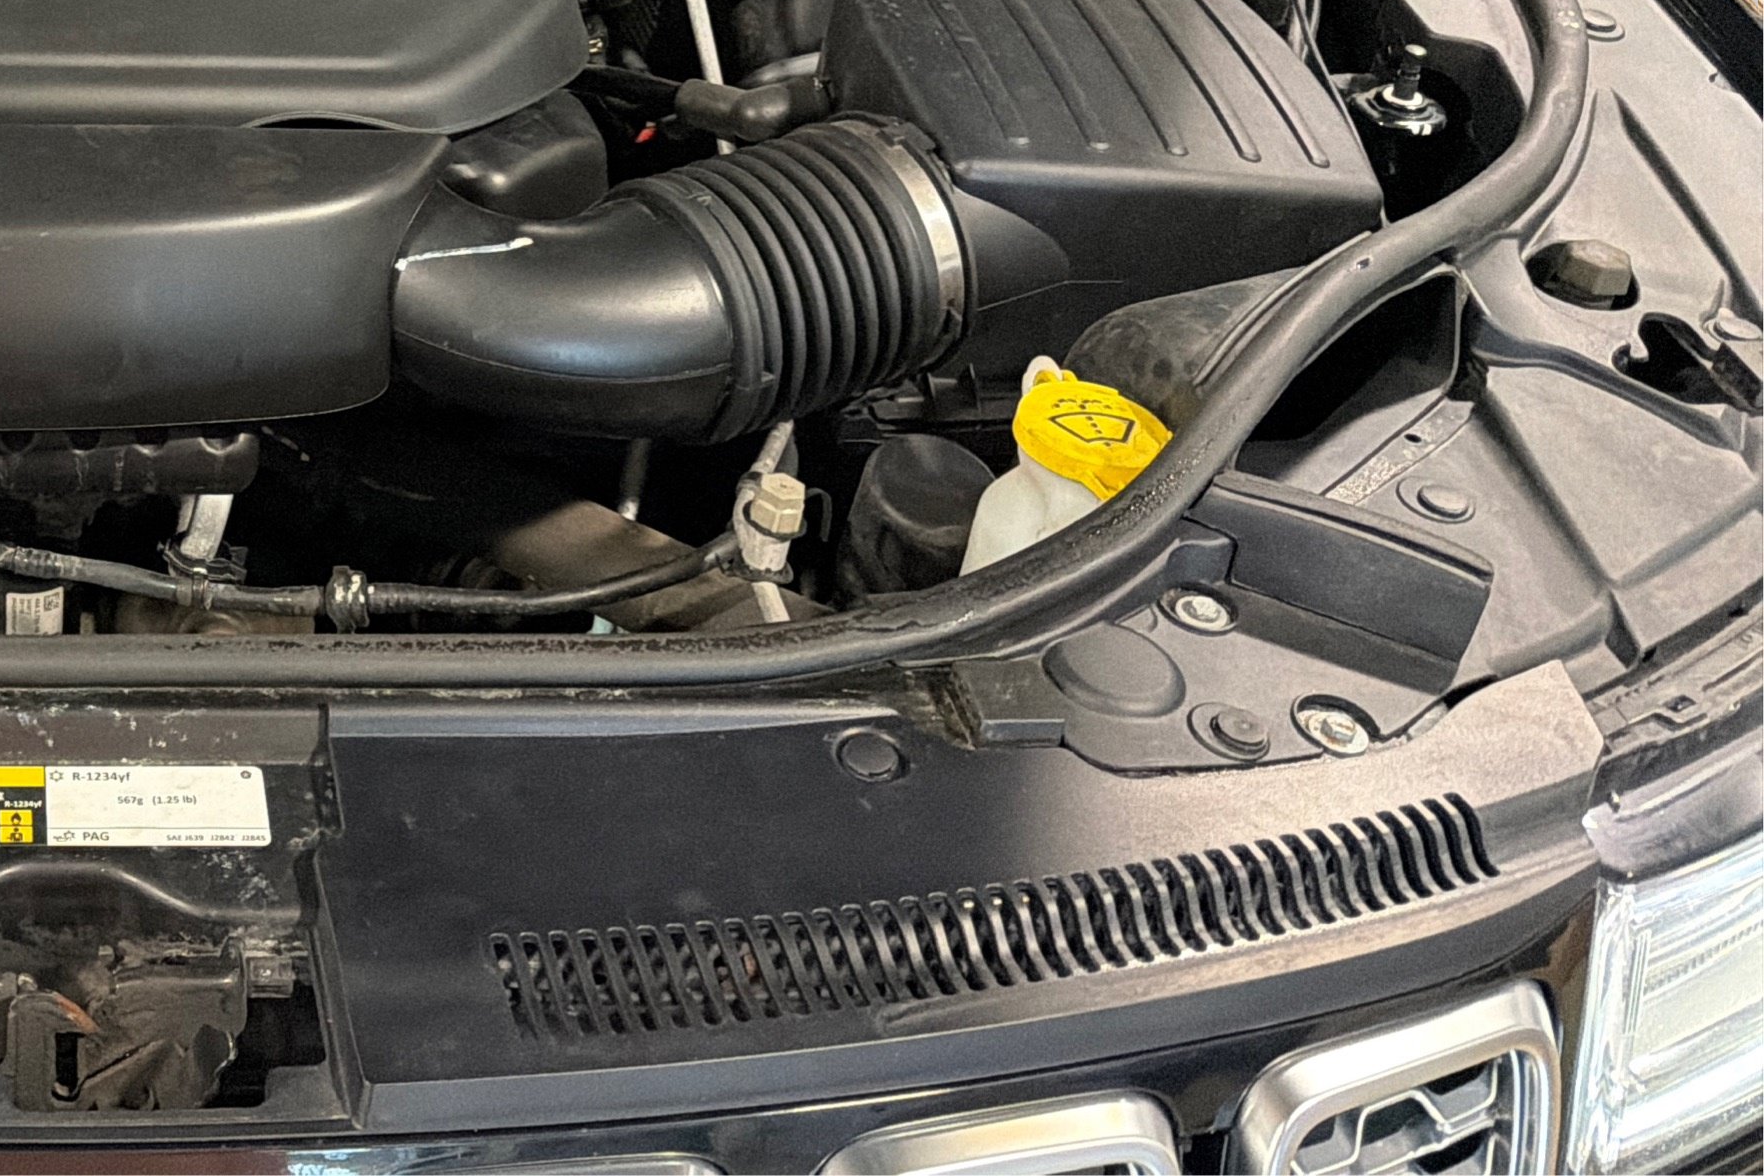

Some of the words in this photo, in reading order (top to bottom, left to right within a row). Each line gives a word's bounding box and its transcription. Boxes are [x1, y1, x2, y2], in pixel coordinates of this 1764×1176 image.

[72, 771, 131, 783] R-1234yf
[3, 800, 43, 809] R-1234yf
[117, 795, 144, 806] 567g
[152, 795, 180, 806] (1.25
[182, 794, 198, 806] lb)
[82, 831, 110, 842] PAG
[166, 834, 182, 842] SAE
